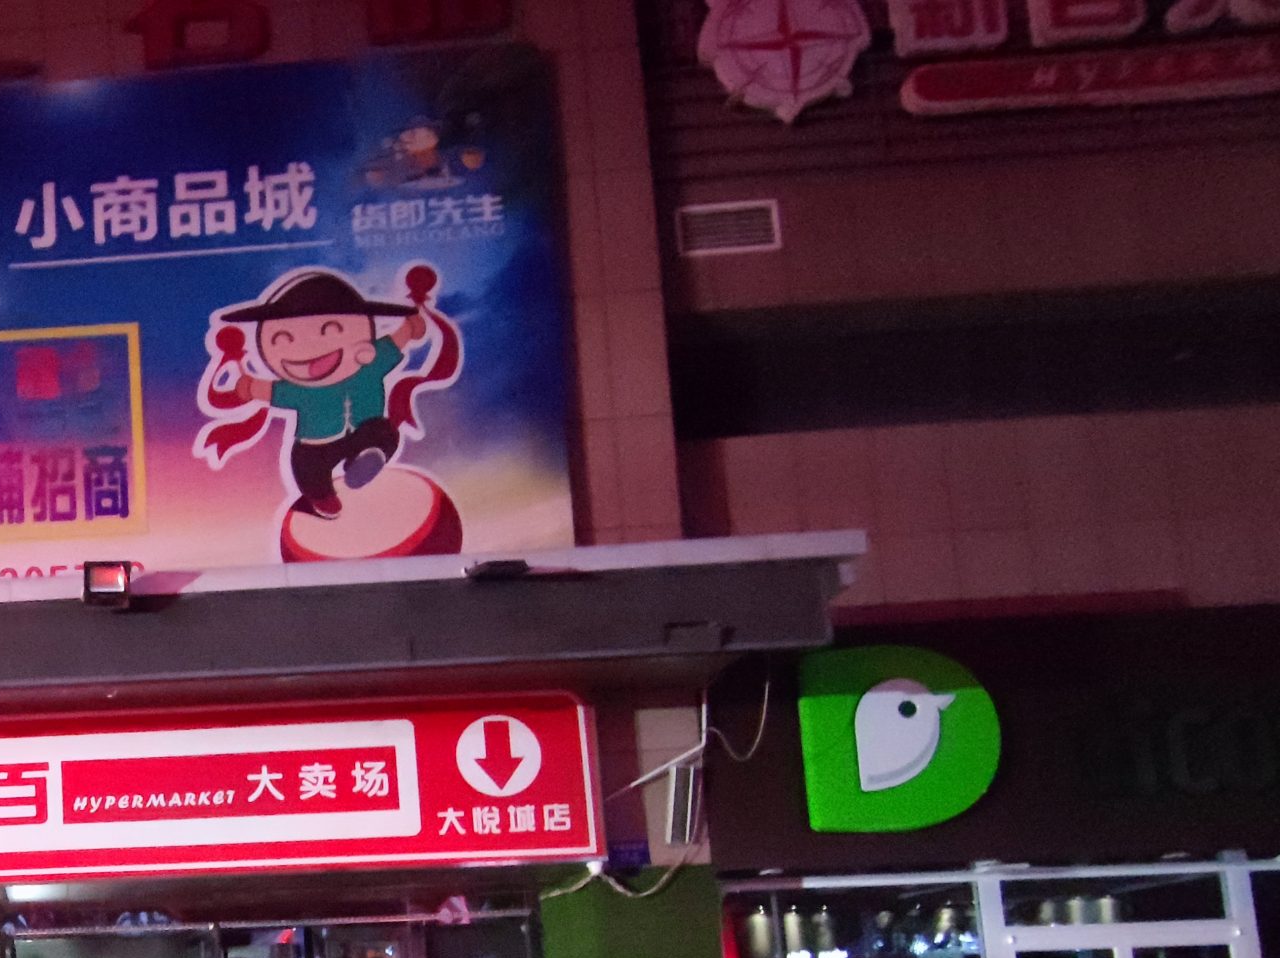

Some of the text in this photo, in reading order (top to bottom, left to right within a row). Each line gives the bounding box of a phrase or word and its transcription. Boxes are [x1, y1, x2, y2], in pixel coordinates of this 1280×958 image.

[15, 161, 317, 249] 小商品城
[246, 760, 391, 803] 大卖场
[73, 789, 236, 814] HYPERMARKET
[436, 803, 572, 836] 大悦城店
